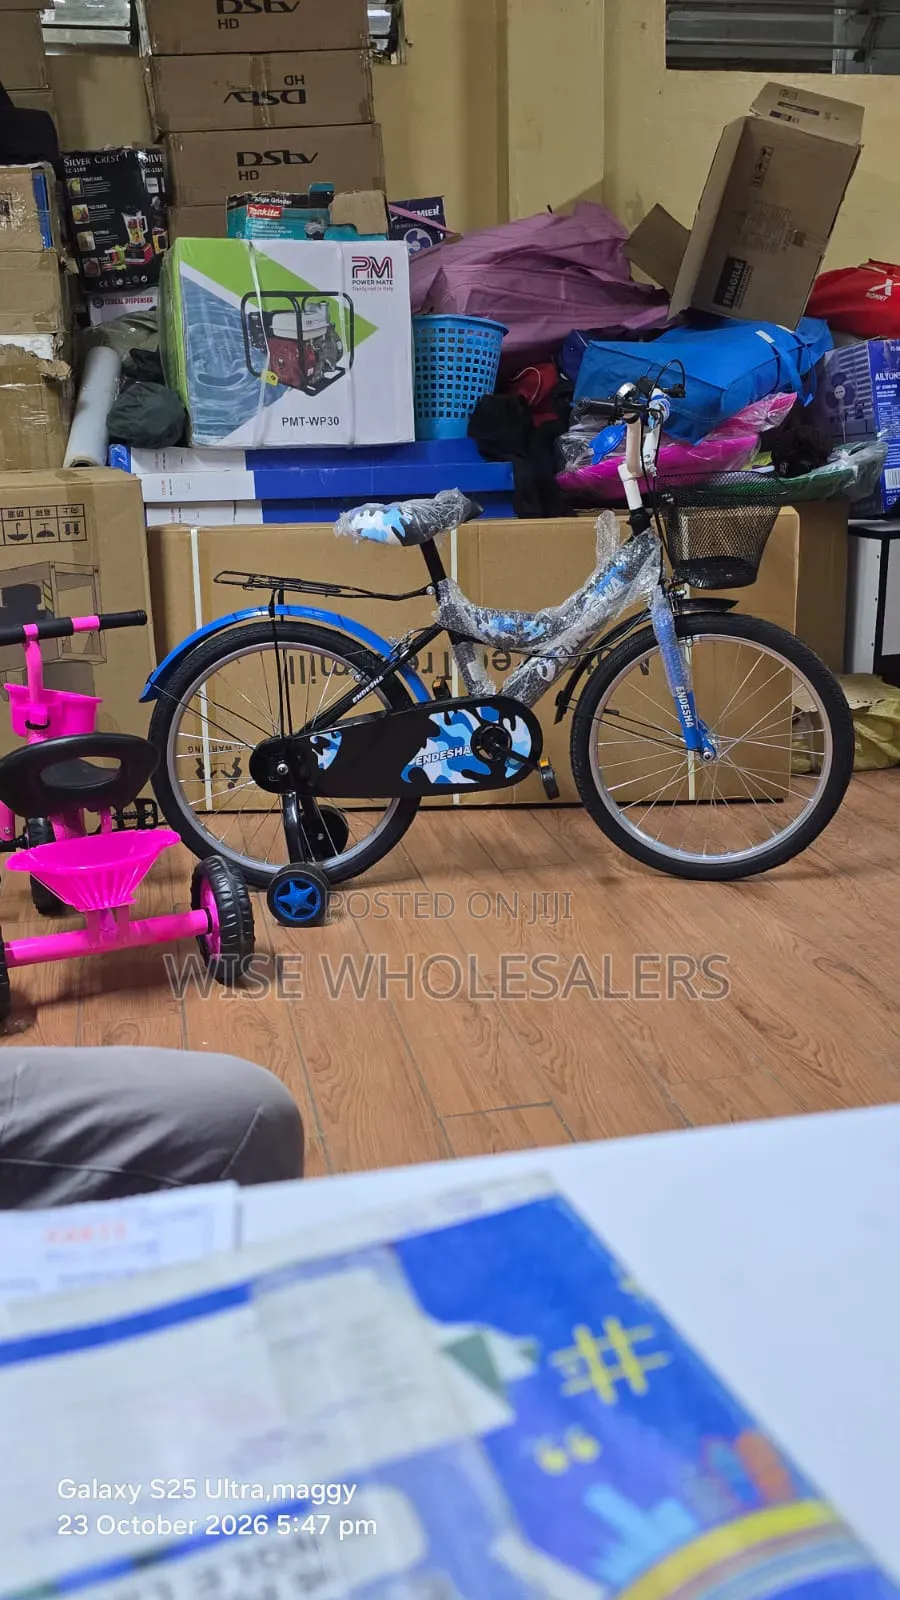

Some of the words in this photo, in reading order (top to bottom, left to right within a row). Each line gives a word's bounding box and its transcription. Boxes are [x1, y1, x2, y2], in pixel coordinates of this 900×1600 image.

[217, 18, 240, 30] HD
[283, 75, 305, 86] HD
[236, 149, 319, 167] DStv
[238, 170, 260, 181] HD
[410, 205, 440, 217] EMIER
[351, 256, 394, 279] PM
[124, 296, 154, 305] DISPENSER
[281, 416, 340, 427] PMT-WP30
[352, 675, 385, 704] ENDESHA
[675, 686, 695, 728] ENDESHA
[187, 744, 233, 755] WARING
[415, 746, 471, 766] ENDESHA
